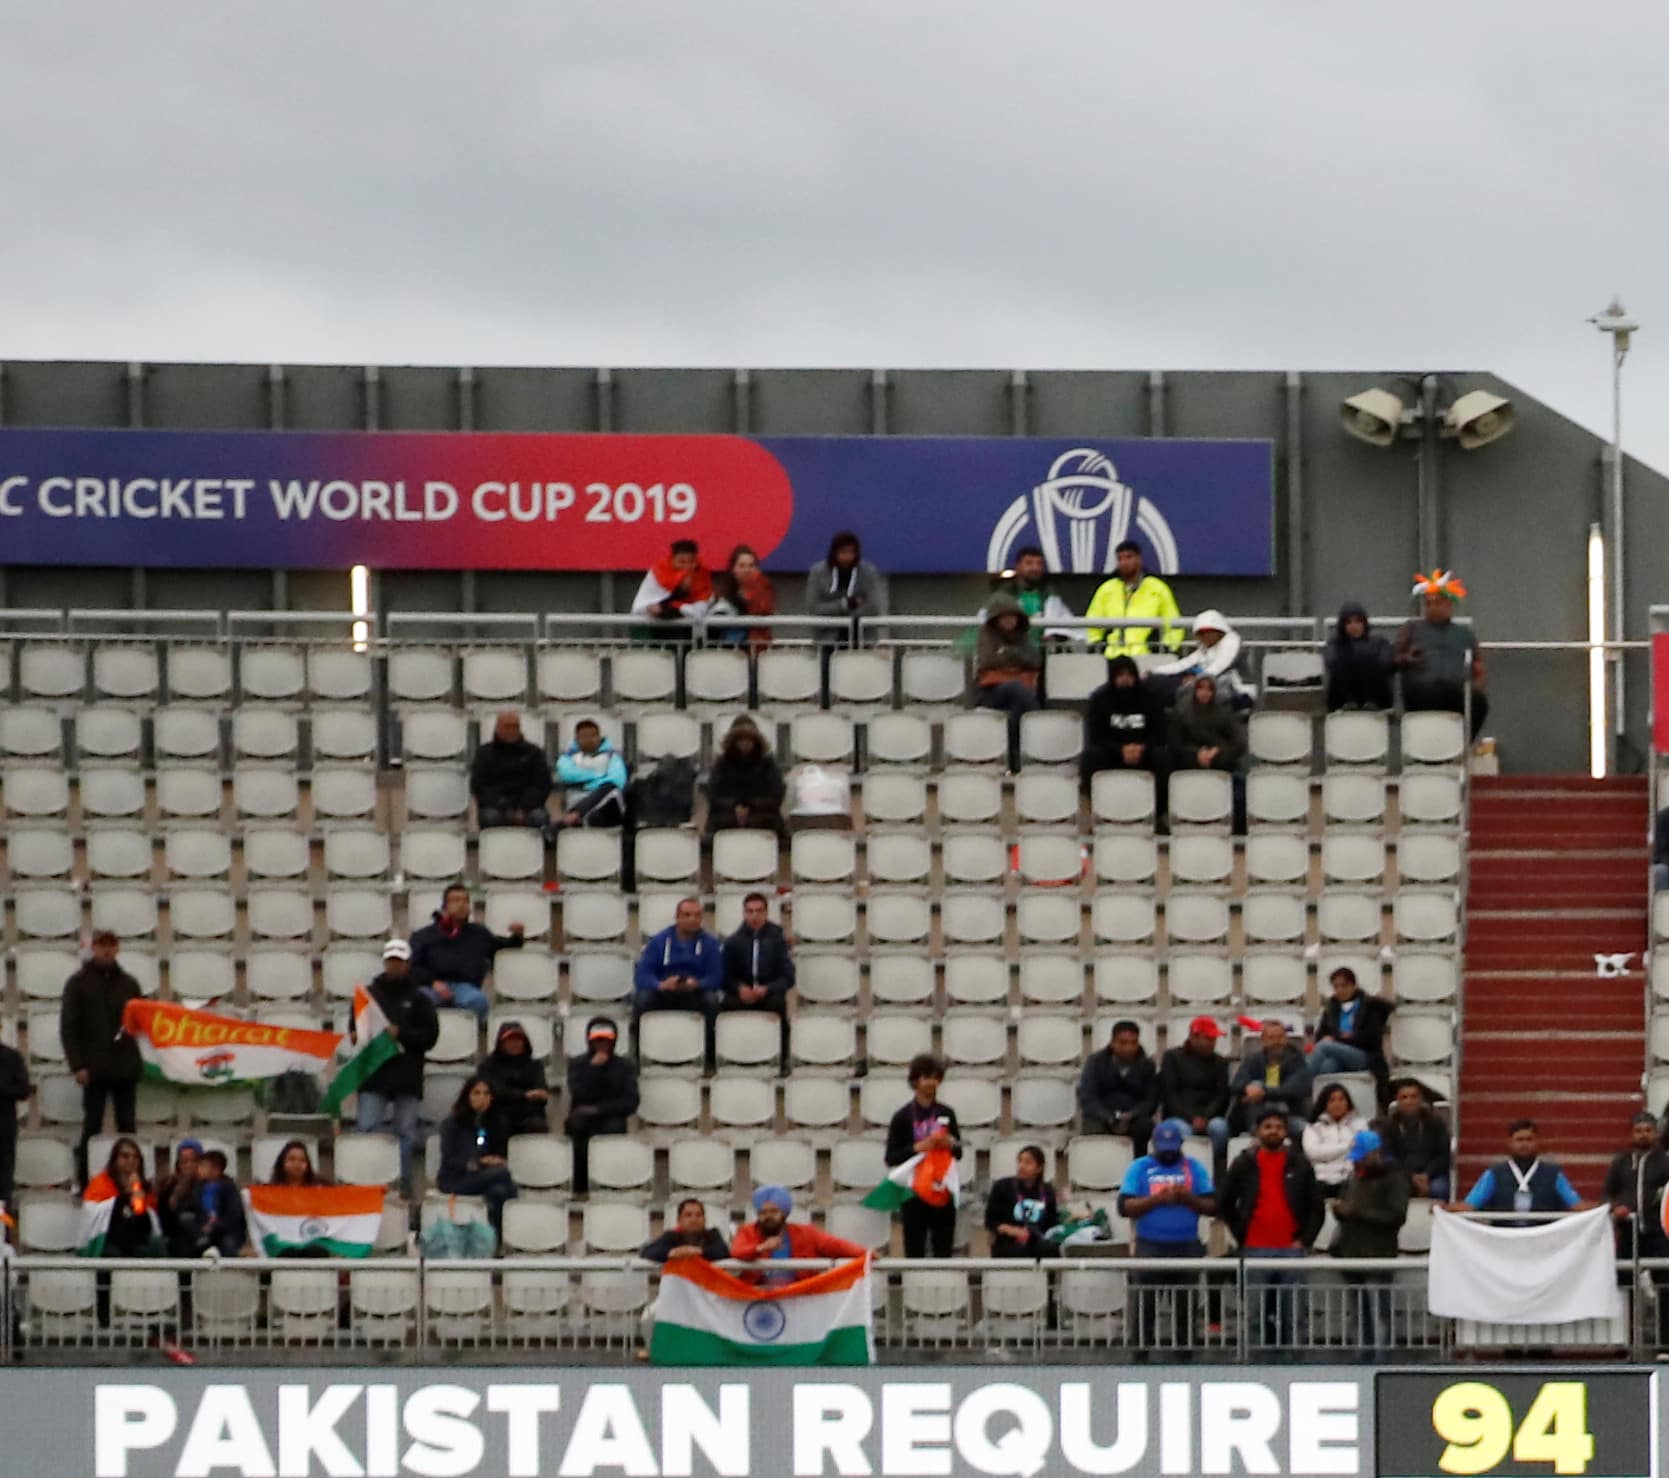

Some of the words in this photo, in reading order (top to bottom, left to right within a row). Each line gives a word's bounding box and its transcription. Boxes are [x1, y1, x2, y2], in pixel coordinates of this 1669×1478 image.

[37, 476, 254, 519] CRICKET
[268, 480, 458, 522] WORLD
[471, 482, 576, 523] CUP
[585, 483, 698, 523] 2019
[151, 1010, 291, 1046] bharat
[94, 1382, 751, 1478] PAKISTAN
[800, 1382, 1360, 1478] REQUIRE
[1431, 1381, 1595, 1476] 94
